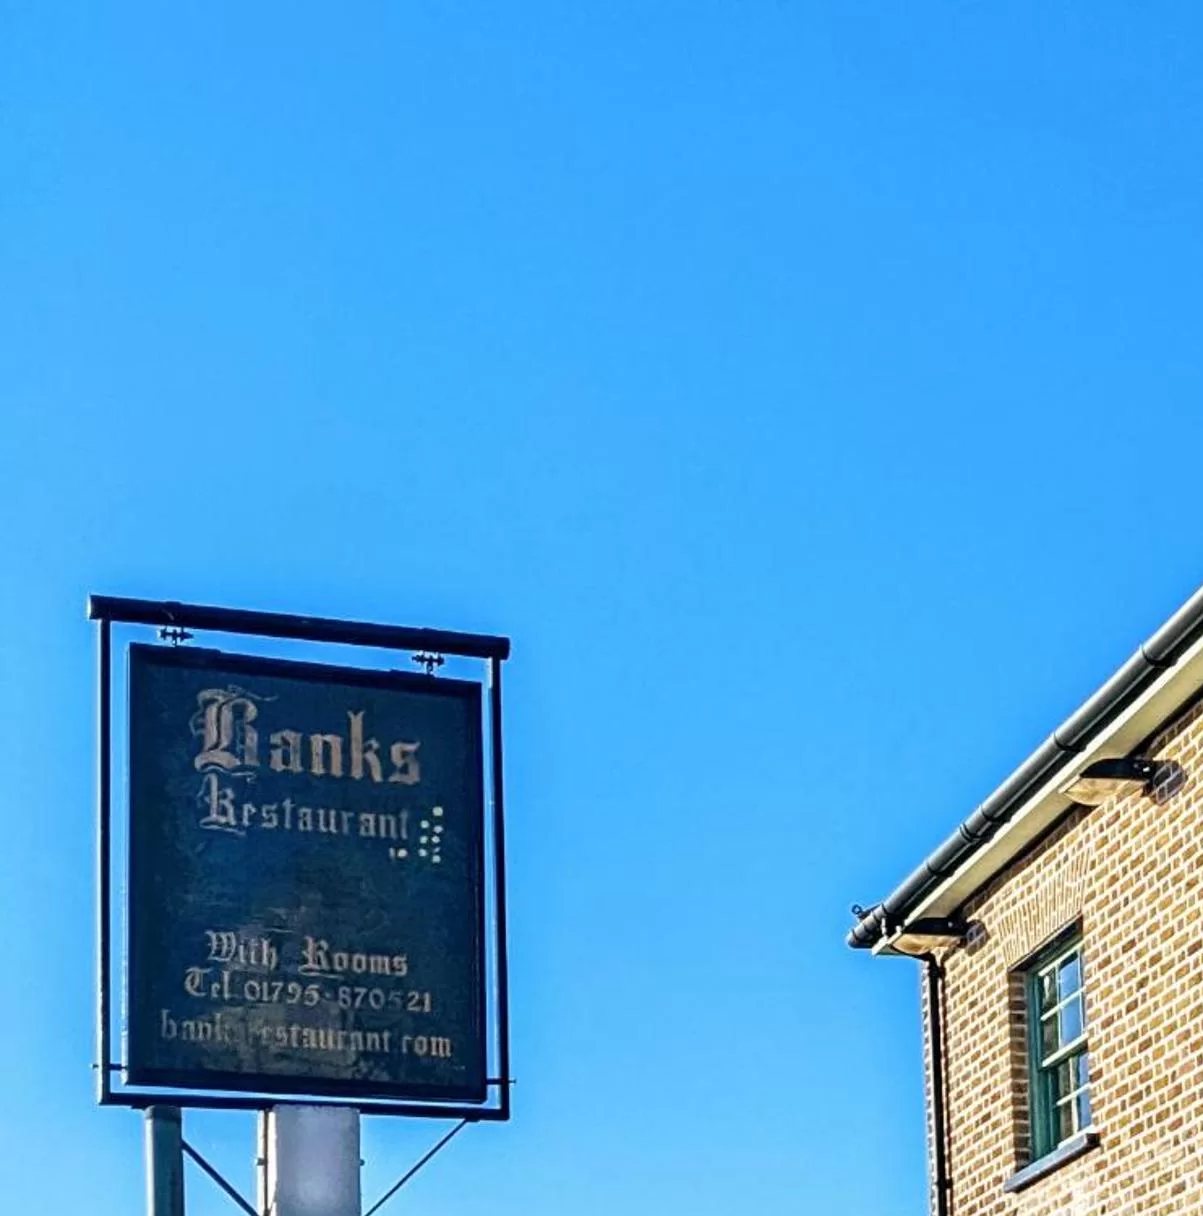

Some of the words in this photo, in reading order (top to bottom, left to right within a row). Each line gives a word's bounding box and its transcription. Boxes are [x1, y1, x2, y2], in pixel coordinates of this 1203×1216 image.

[189, 685, 421, 786] Banks
[196, 772, 409, 841] Restaurant
[205, 930, 278, 971] With
[298, 935, 409, 978] Rooms
